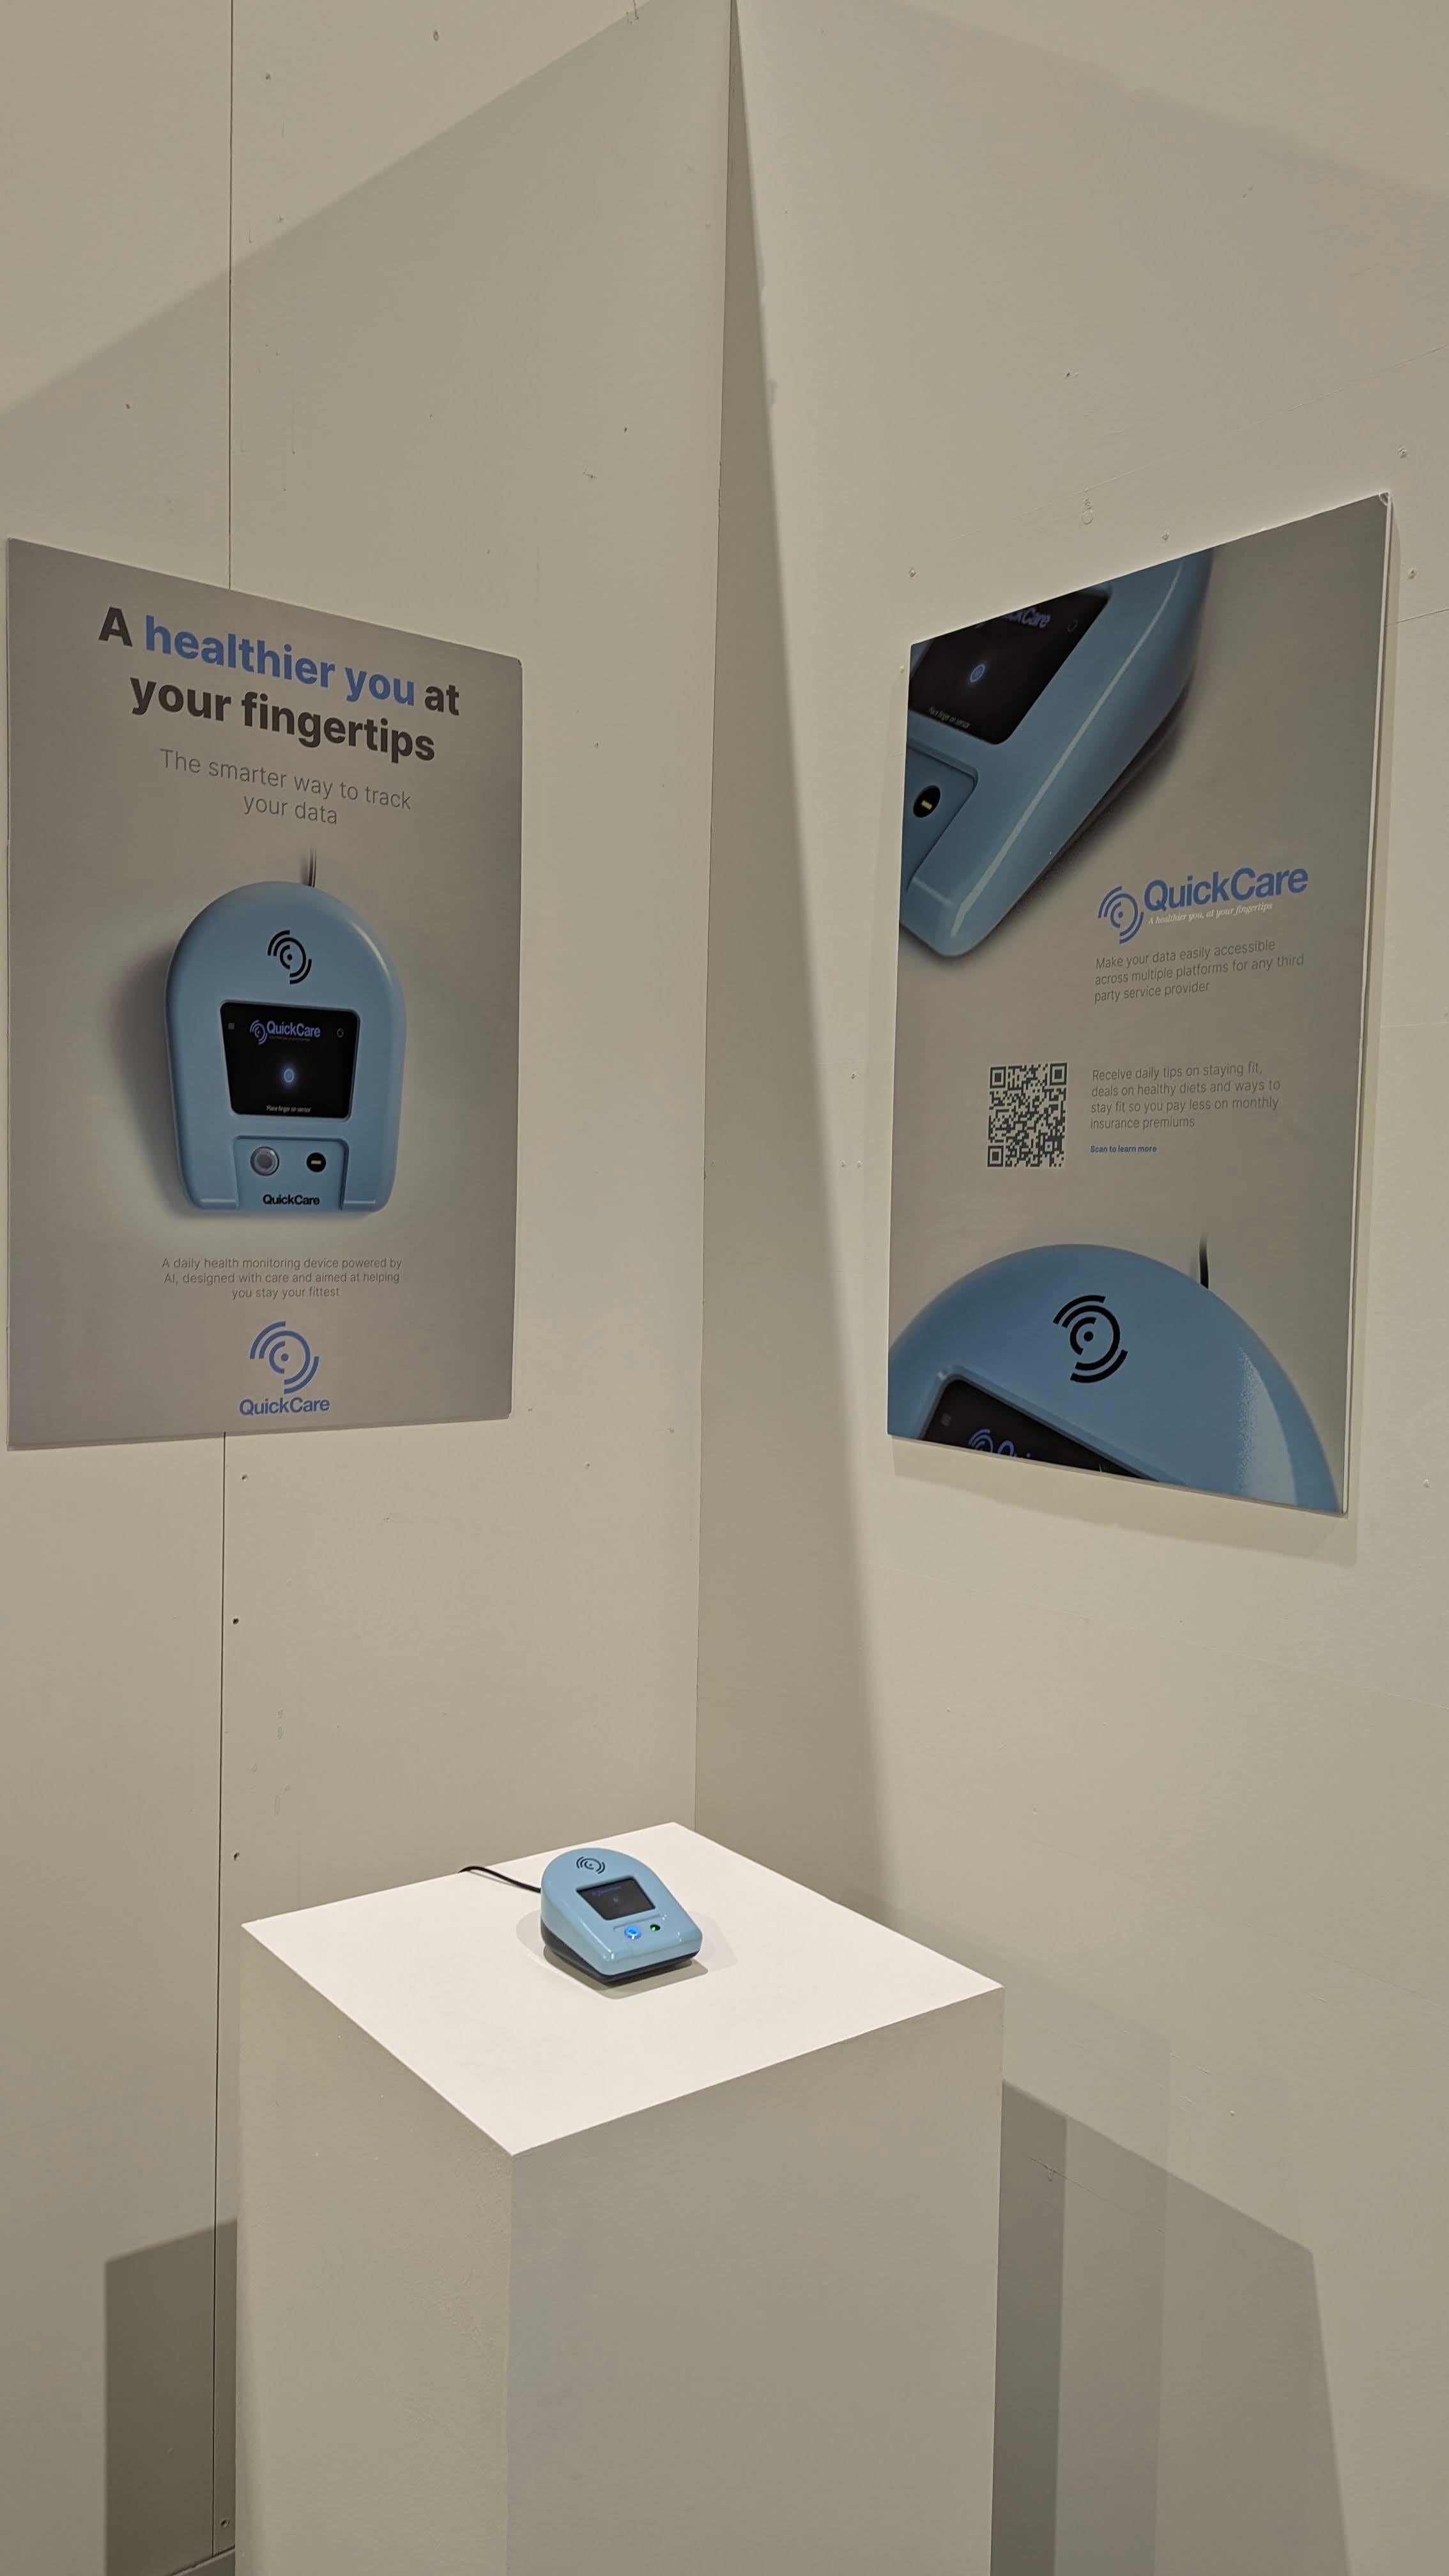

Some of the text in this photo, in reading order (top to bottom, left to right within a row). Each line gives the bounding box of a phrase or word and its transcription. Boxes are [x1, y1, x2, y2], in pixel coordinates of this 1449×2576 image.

[98, 606, 459, 716] A healthier you at
[130, 677, 435, 764] your fingertips
[160, 749, 411, 810] The smarter way to track
[243, 795, 338, 825] your data
[1144, 867, 1309, 912] QuickCare
[1148, 916, 1154, 925] A
[1156, 913, 1187, 924] healthier
[1206, 909, 1214, 918] at
[1215, 907, 1234, 919] your
[1234, 901, 1273, 916] fingertips
[1096, 939, 1276, 969] Make your data easily accessible
[1095, 953, 1305, 985] across multiple platforms for any third
[1094, 981, 1211, 1005] party service provider
[266, 1020, 321, 1038] QuickCare
[1092, 1061, 1263, 1081] Receive daily tips on staying fit,
[1091, 1079, 1281, 1097] deals on healthy diets and ways to
[1091, 1096, 1279, 1116] stay fit so you pay less on monthly
[1090, 1116, 1195, 1131] insurance premiums
[263, 1193, 320, 1205] QuickCare
[162, 1257, 402, 1270] A daily health monitoring device powered by
[164, 1272, 400, 1285] AI, designed with care and aimed at helping
[232, 1286, 340, 1300] you stay your fittest
[239, 1397, 330, 1416] QuickCare
